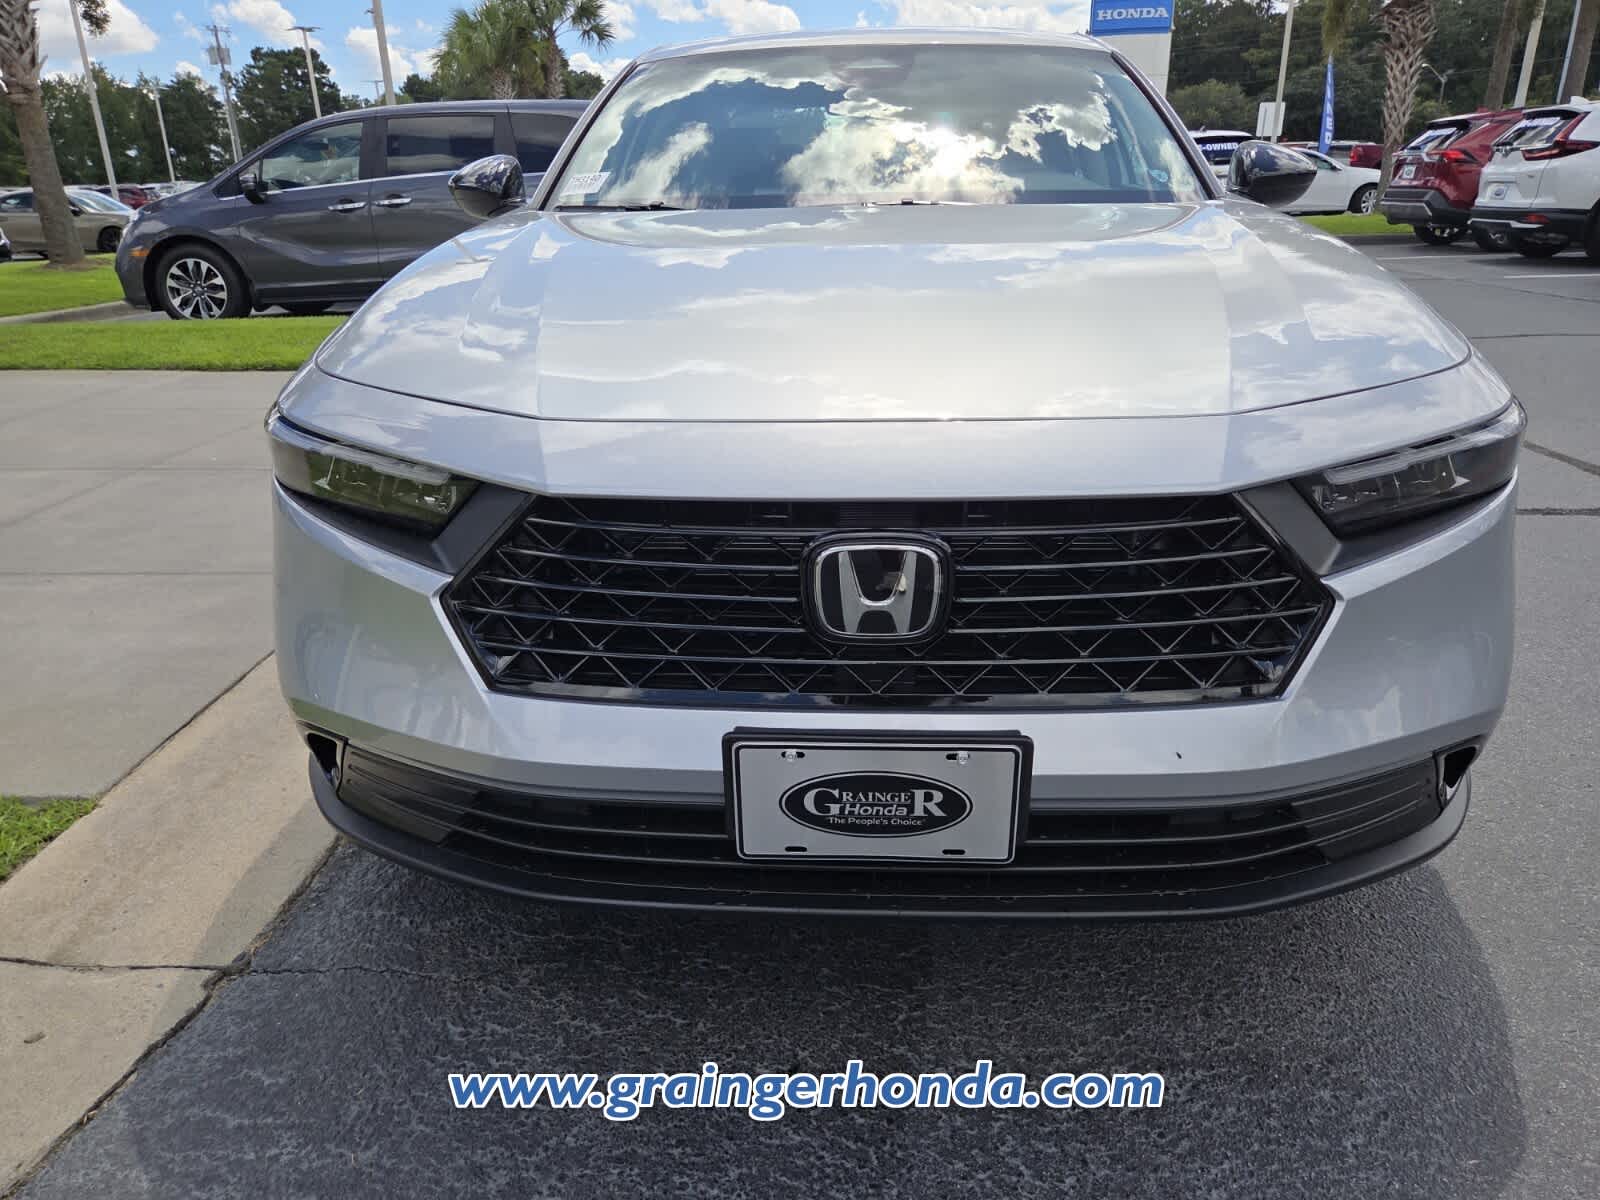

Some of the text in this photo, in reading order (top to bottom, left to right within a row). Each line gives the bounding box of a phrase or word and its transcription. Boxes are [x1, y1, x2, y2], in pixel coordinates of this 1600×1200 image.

[1096, 7, 1169, 20] HONDA
[803, 787, 948, 817] GRAINGER
[844, 803, 908, 816] Honda
[828, 817, 923, 826] The People's Choice
